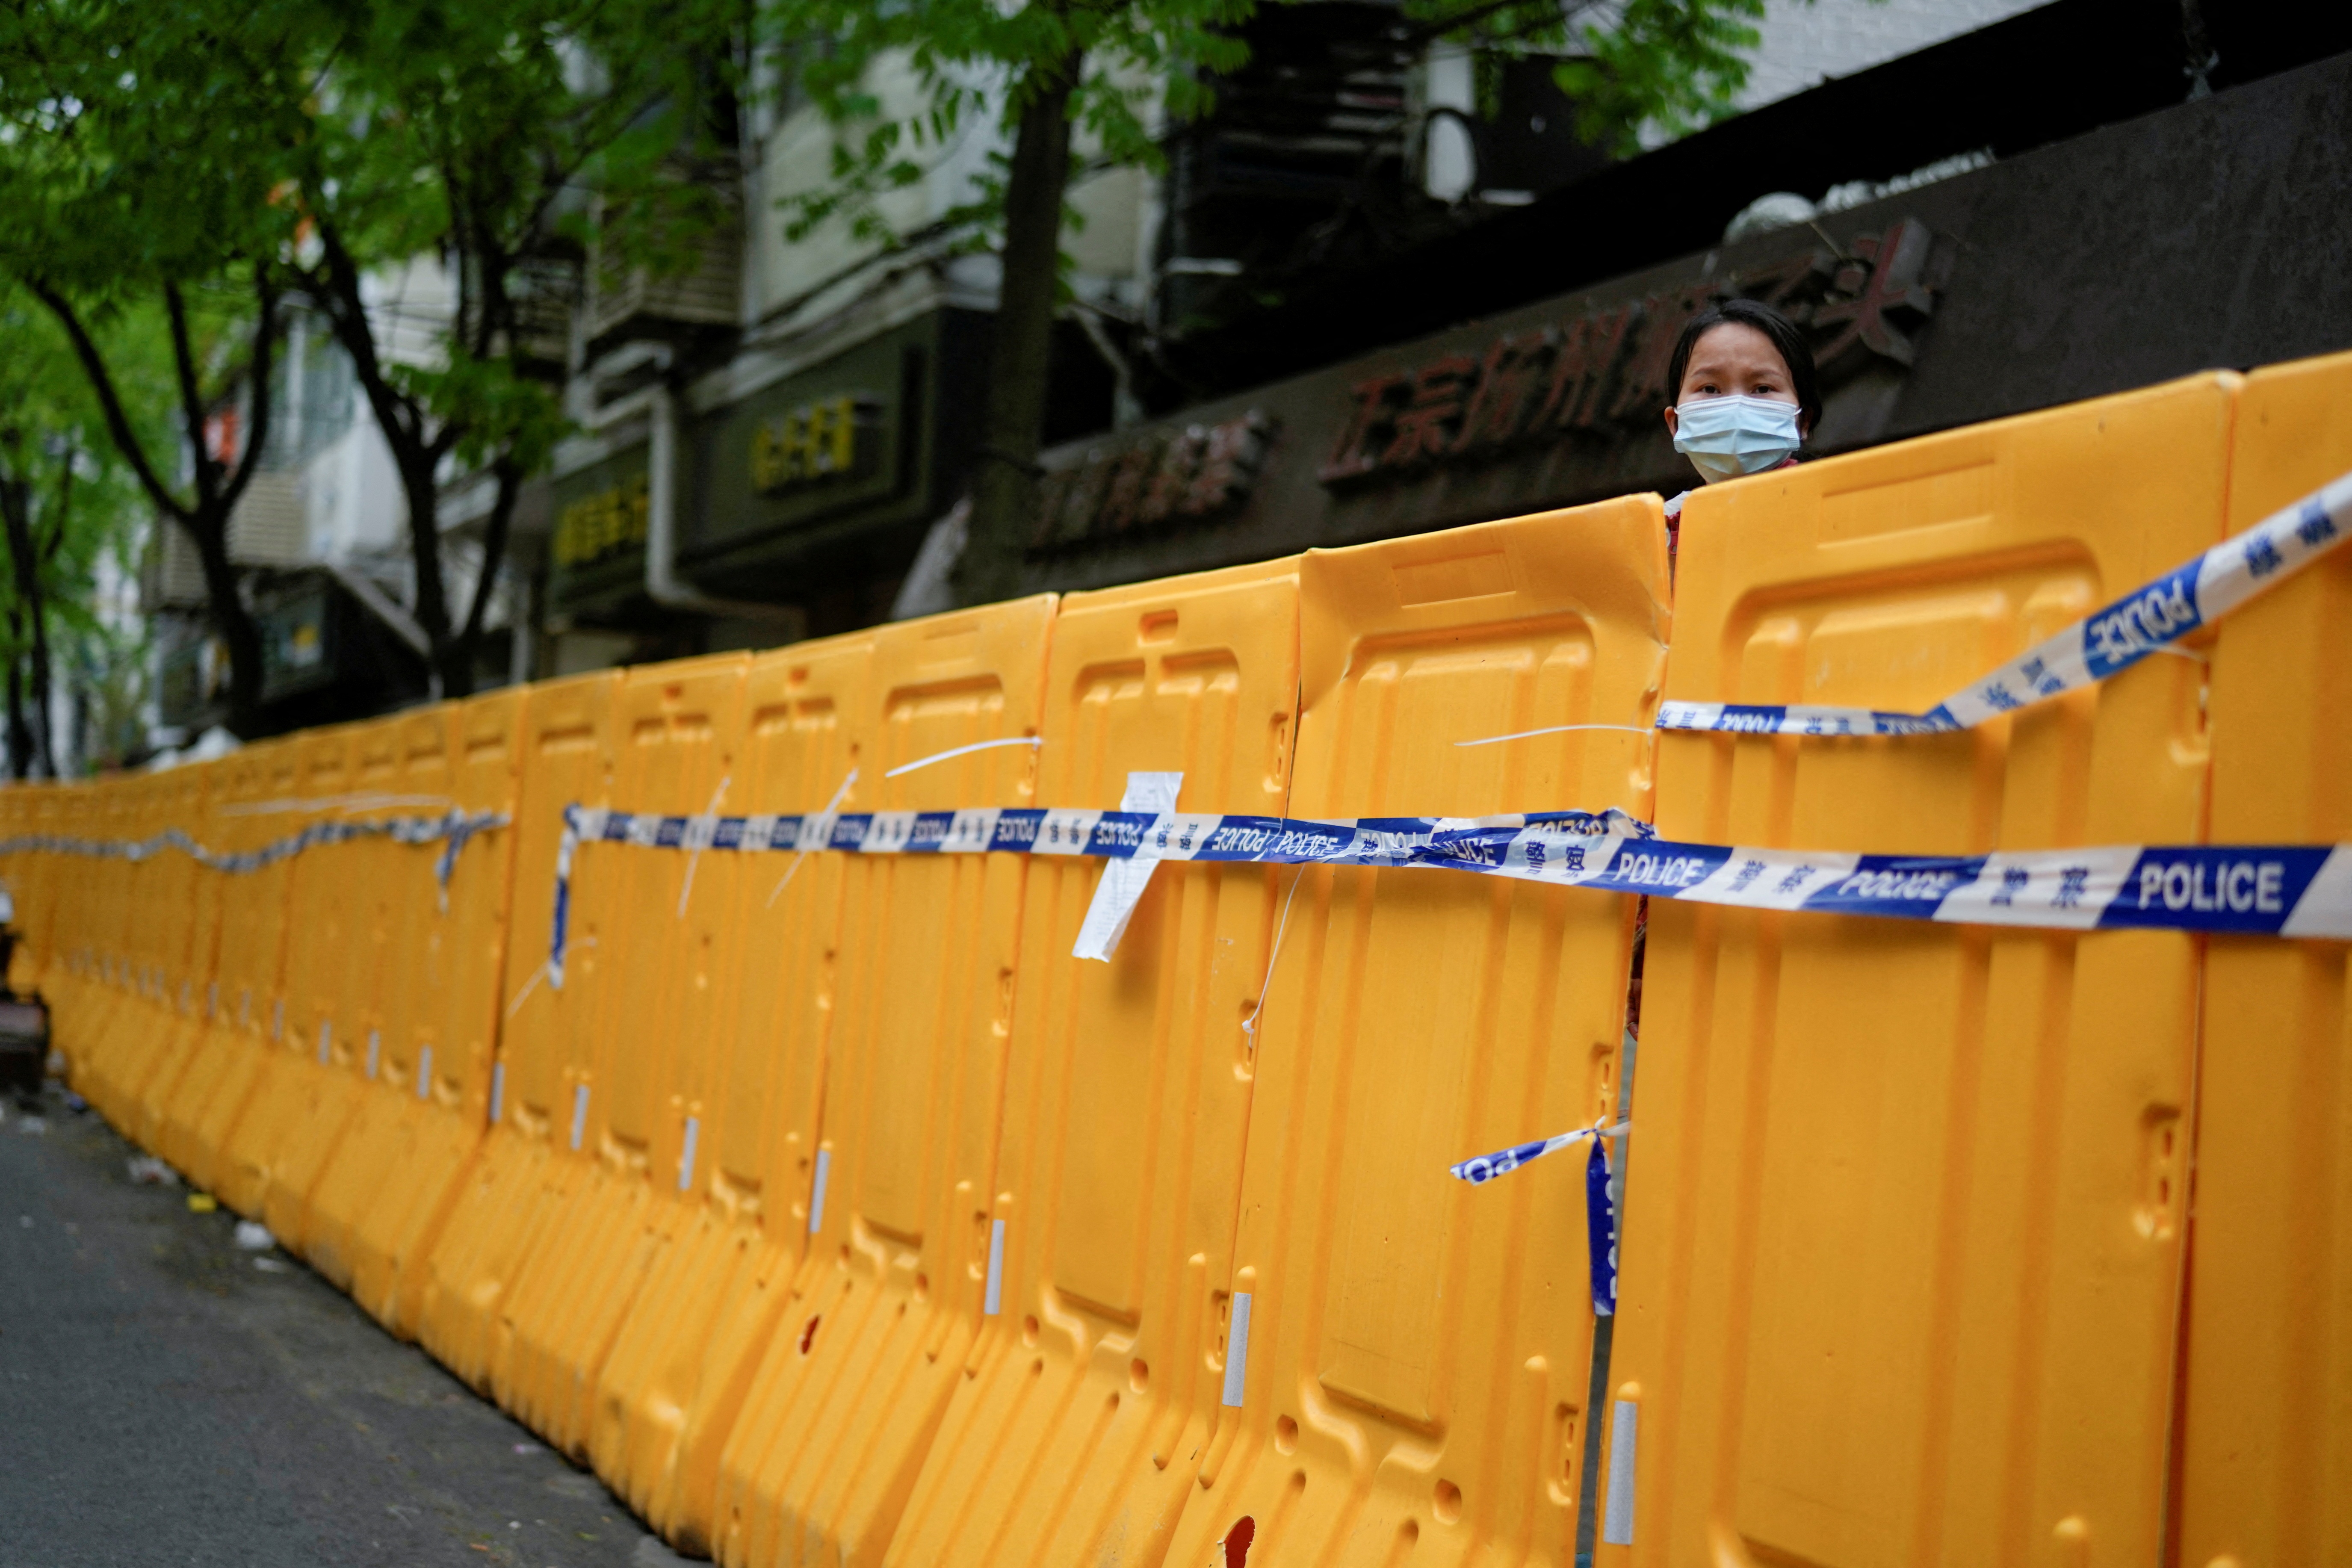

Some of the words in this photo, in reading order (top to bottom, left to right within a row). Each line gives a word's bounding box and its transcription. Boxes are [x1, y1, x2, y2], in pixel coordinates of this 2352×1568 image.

[2089, 577, 2195, 664] POLICE
[997, 817, 1036, 842] POLICE
[1096, 821, 1143, 846] POLICE
[1211, 827, 1270, 852] POLICE
[1275, 830, 1338, 856] POLICE
[1525, 838, 1586, 879] 警察
[1611, 853, 1705, 887] POLICE
[1838, 870, 1956, 900] POLICE
[2138, 860, 2286, 913] POLICE
